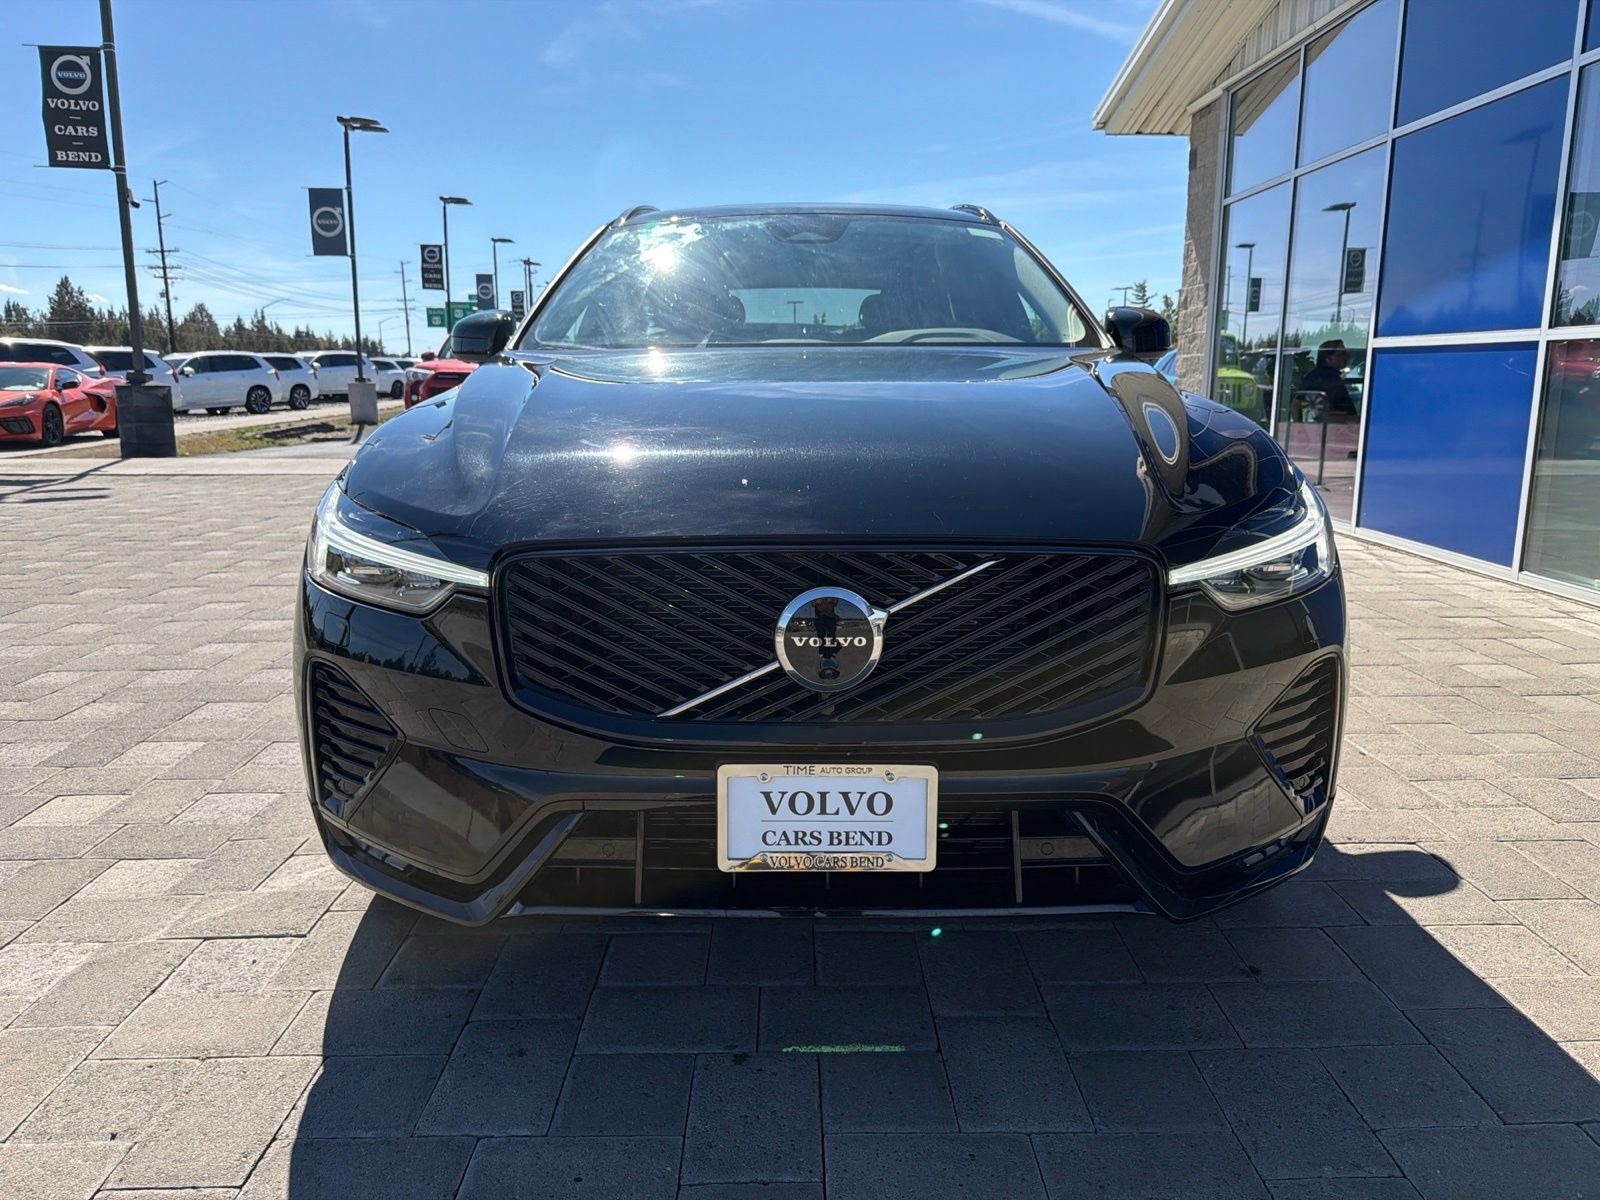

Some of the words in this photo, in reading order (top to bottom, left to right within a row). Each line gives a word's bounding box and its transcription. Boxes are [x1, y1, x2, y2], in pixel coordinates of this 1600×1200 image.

[57, 71, 86, 79] VOLVO
[46, 98, 100, 111] VOLVO
[54, 124, 98, 137] CARS
[55, 150, 102, 162] BEND
[791, 636, 867, 647] VOLVO
[783, 765, 816, 776] TIME
[819, 766, 843, 774] AUTO
[845, 766, 873, 775] GROUP
[760, 790, 894, 816] VOLVO
[761, 830, 822, 847] CARS
[828, 830, 893, 846] BEND
[769, 856, 812, 868] VOLVO
[814, 855, 848, 868] CARS
[850, 856, 885, 868] BEND
